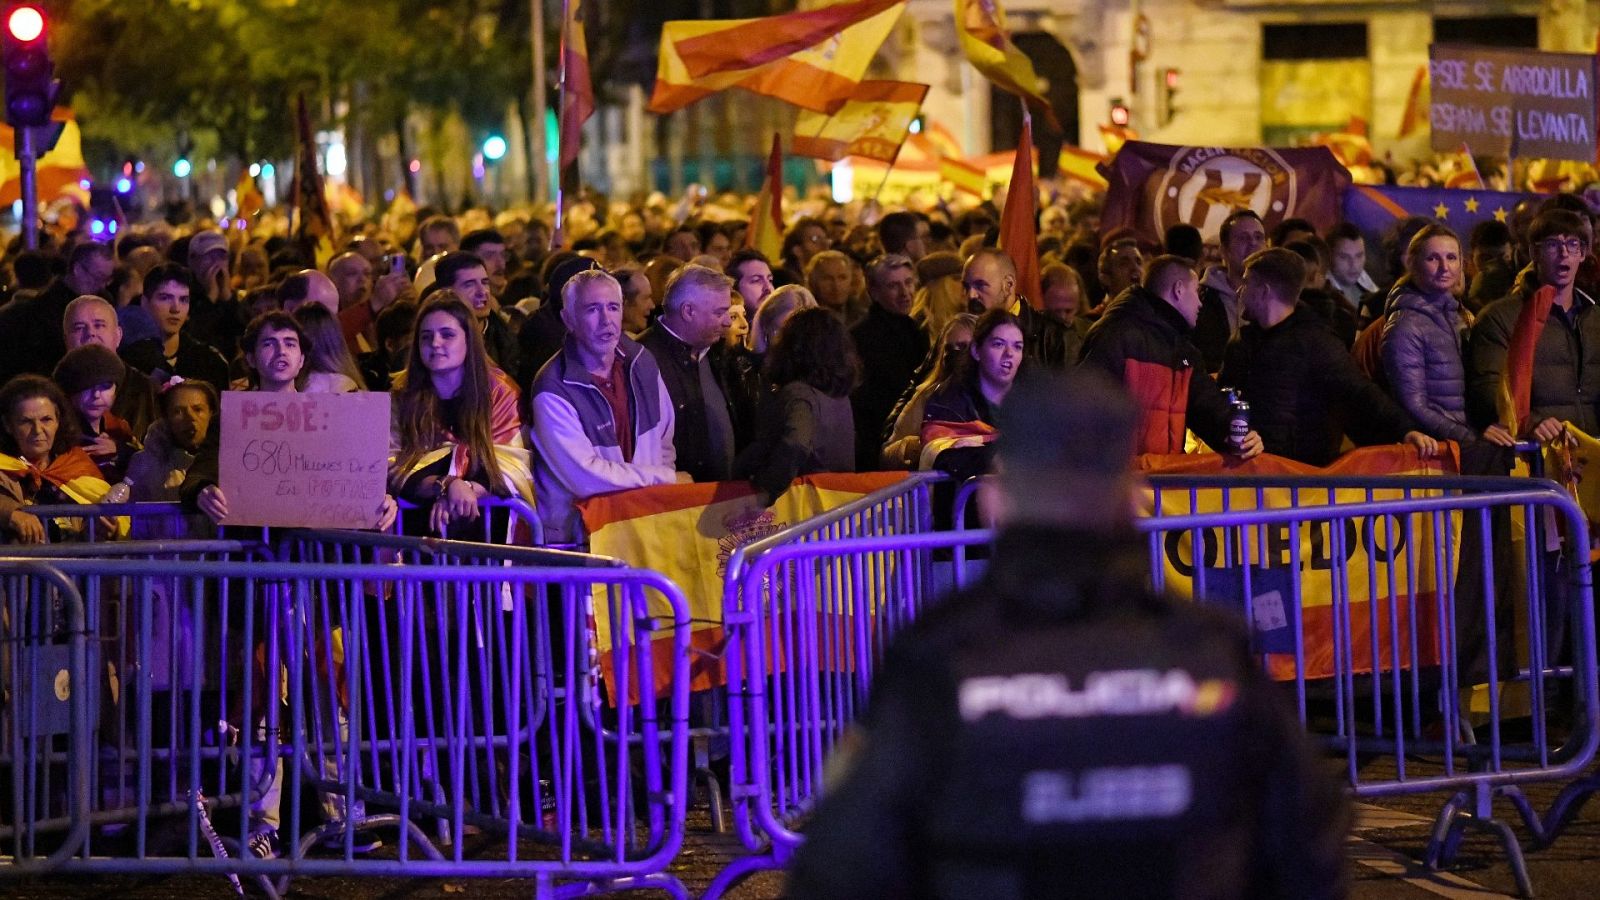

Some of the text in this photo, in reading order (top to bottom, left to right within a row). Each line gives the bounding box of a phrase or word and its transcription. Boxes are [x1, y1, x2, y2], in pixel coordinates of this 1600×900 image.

[1430, 60, 1588, 98] PSOE SE ARRODILLA
[1490, 105, 1511, 136] SE
[1517, 110, 1589, 144] LEVANTA
[240, 400, 329, 433] PSOE:
[242, 439, 292, 475] 680
